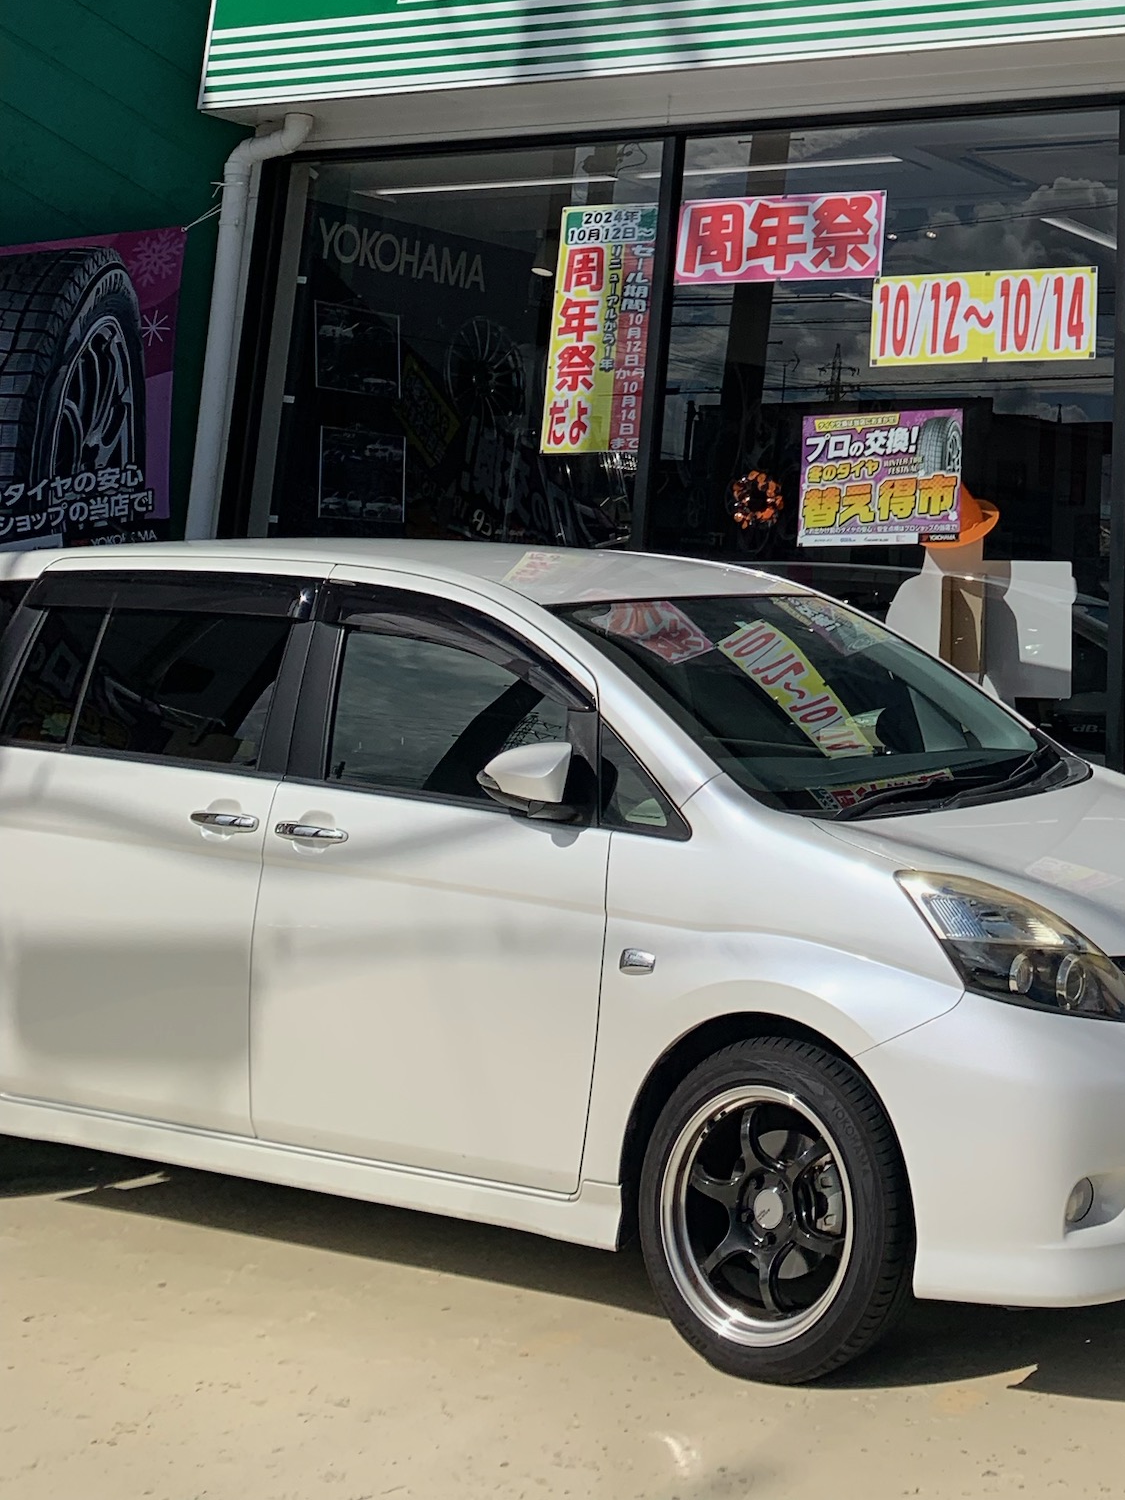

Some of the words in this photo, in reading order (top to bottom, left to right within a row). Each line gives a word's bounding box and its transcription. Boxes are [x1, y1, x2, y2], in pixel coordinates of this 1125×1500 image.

[583, 210, 639, 225] 2024年
[681, 195, 874, 275] 周年祭
[319, 217, 485, 292] YOKOHAMA
[621, 244, 655, 312] セール期間
[878, 276, 1085, 358] 10/12～10/14
[547, 246, 605, 445] 周年祭だよ
[805, 426, 920, 463] プロの交換!
[808, 458, 881, 484] 冬のタイヤ
[0, 464, 144, 506] タイヤの安心
[802, 474, 958, 529] 替え得市
[929, 533, 956, 542] YOKOHAMA
